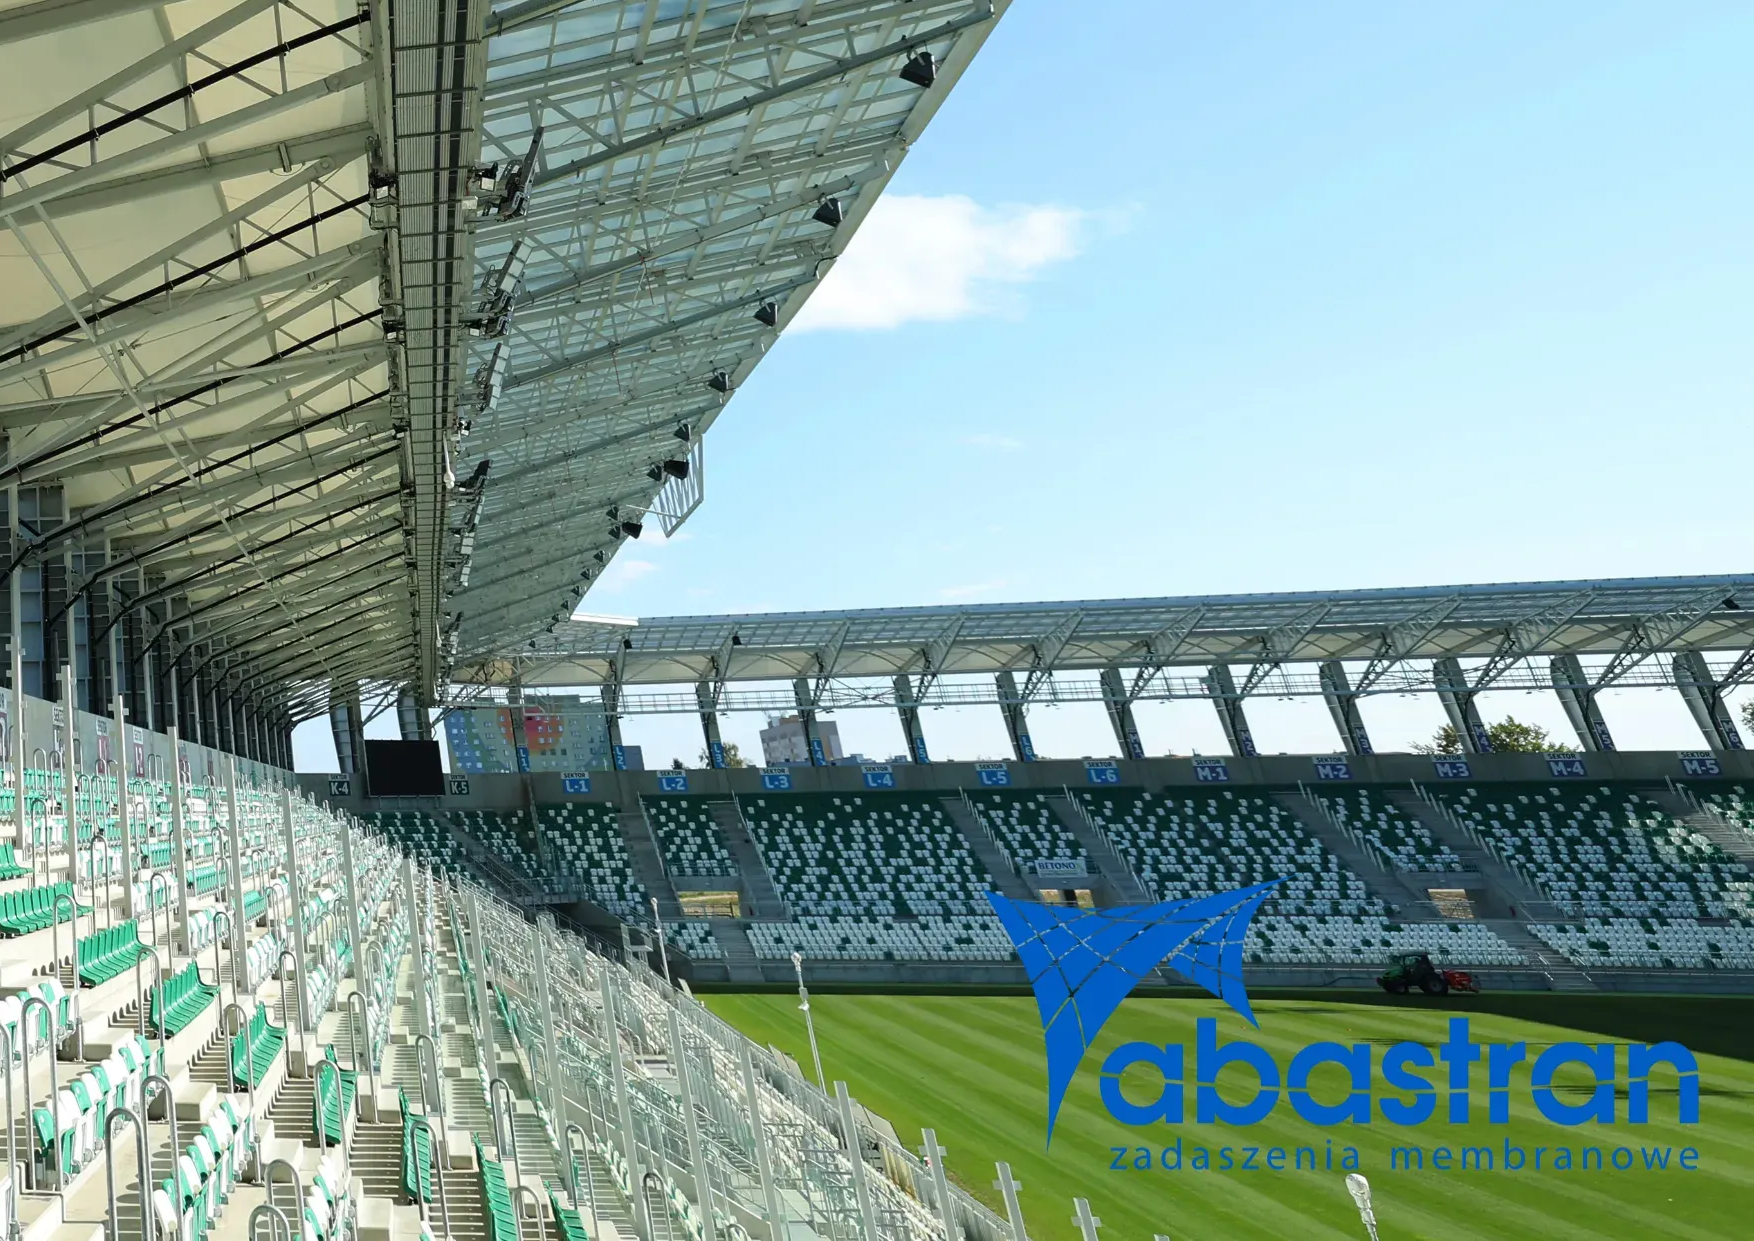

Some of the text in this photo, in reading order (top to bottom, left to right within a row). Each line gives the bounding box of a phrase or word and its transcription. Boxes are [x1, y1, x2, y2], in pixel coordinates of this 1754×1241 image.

[1316, 756, 1343, 764] SEKTOR
[1317, 765, 1349, 779] M-2
[1436, 763, 1469, 777] M-3
[1550, 761, 1584, 776] M-4
[1683, 760, 1720, 774] M-5
[867, 774, 893, 787] L-4
[981, 771, 1007, 784] L-5
[1091, 769, 1117, 782] L-6
[1197, 767, 1228, 781] M-1
[331, 782, 349, 794] K-4
[451, 782, 468, 794] K-5
[566, 780, 589, 792] L-1
[662, 778, 685, 790] L-2
[765, 776, 789, 788] L-3
